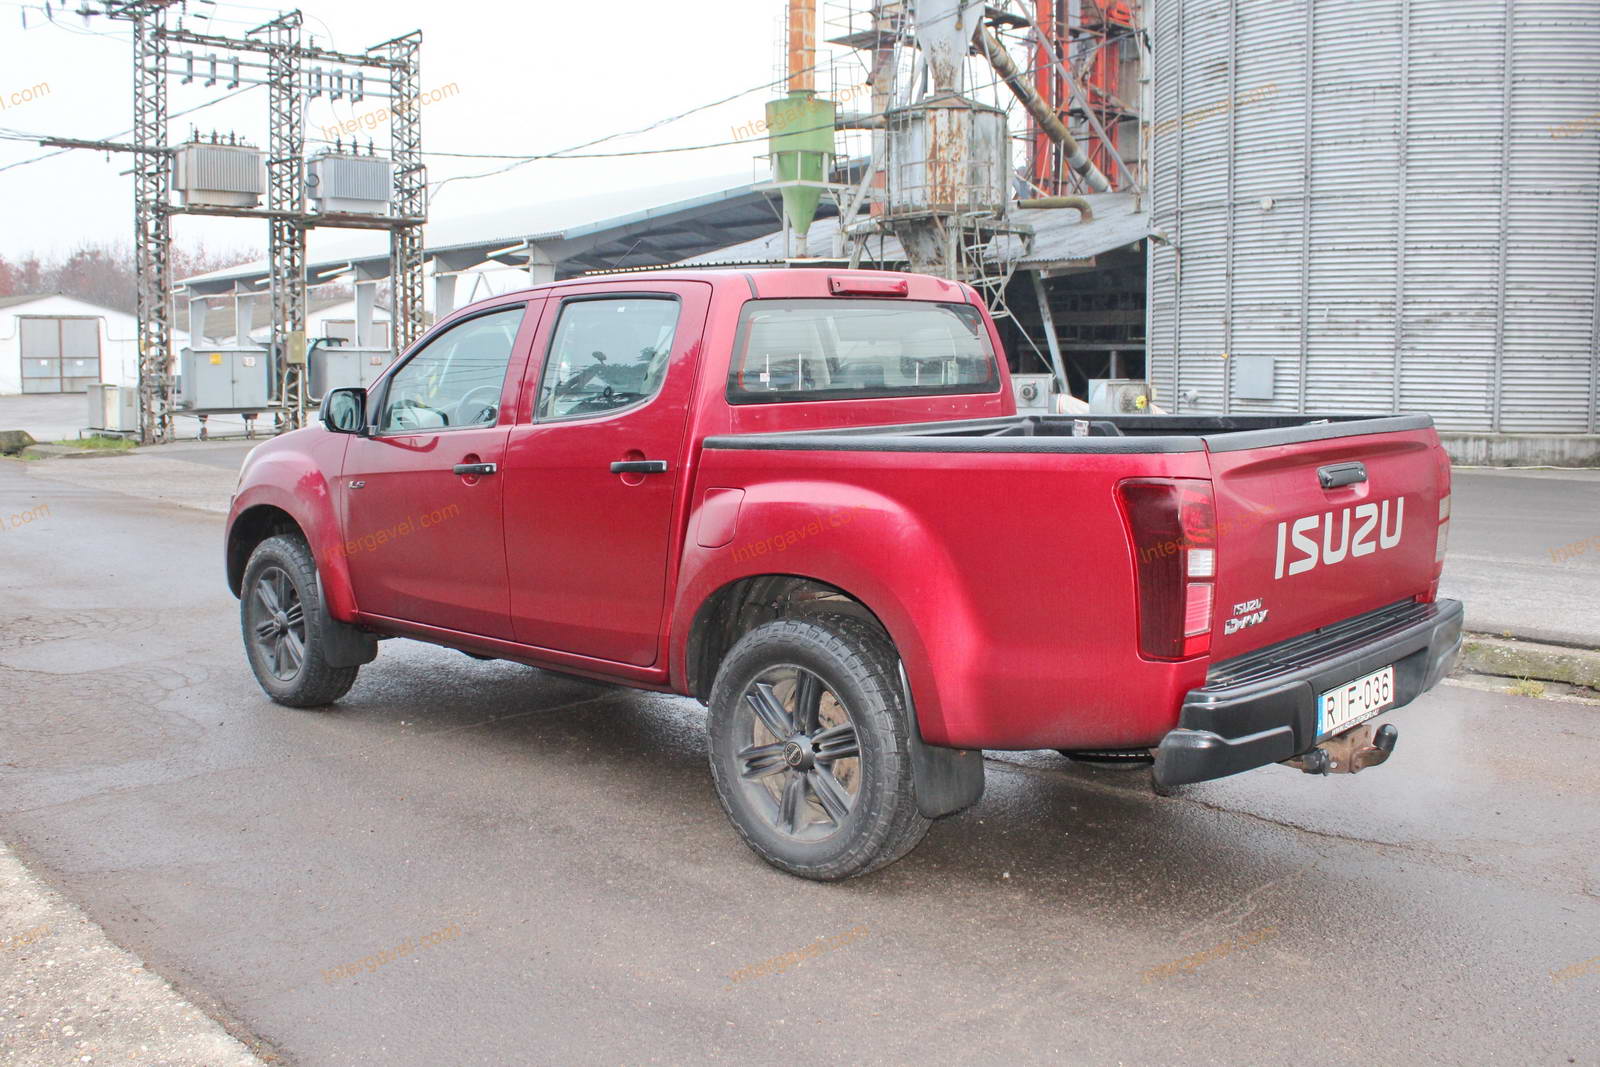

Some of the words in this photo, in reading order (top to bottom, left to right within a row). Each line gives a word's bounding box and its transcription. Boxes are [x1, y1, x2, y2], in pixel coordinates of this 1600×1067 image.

[1274, 496, 1405, 580] ISUZU
[1232, 597, 1264, 616] ISUZU
[1326, 672, 1389, 729] RIF-036
